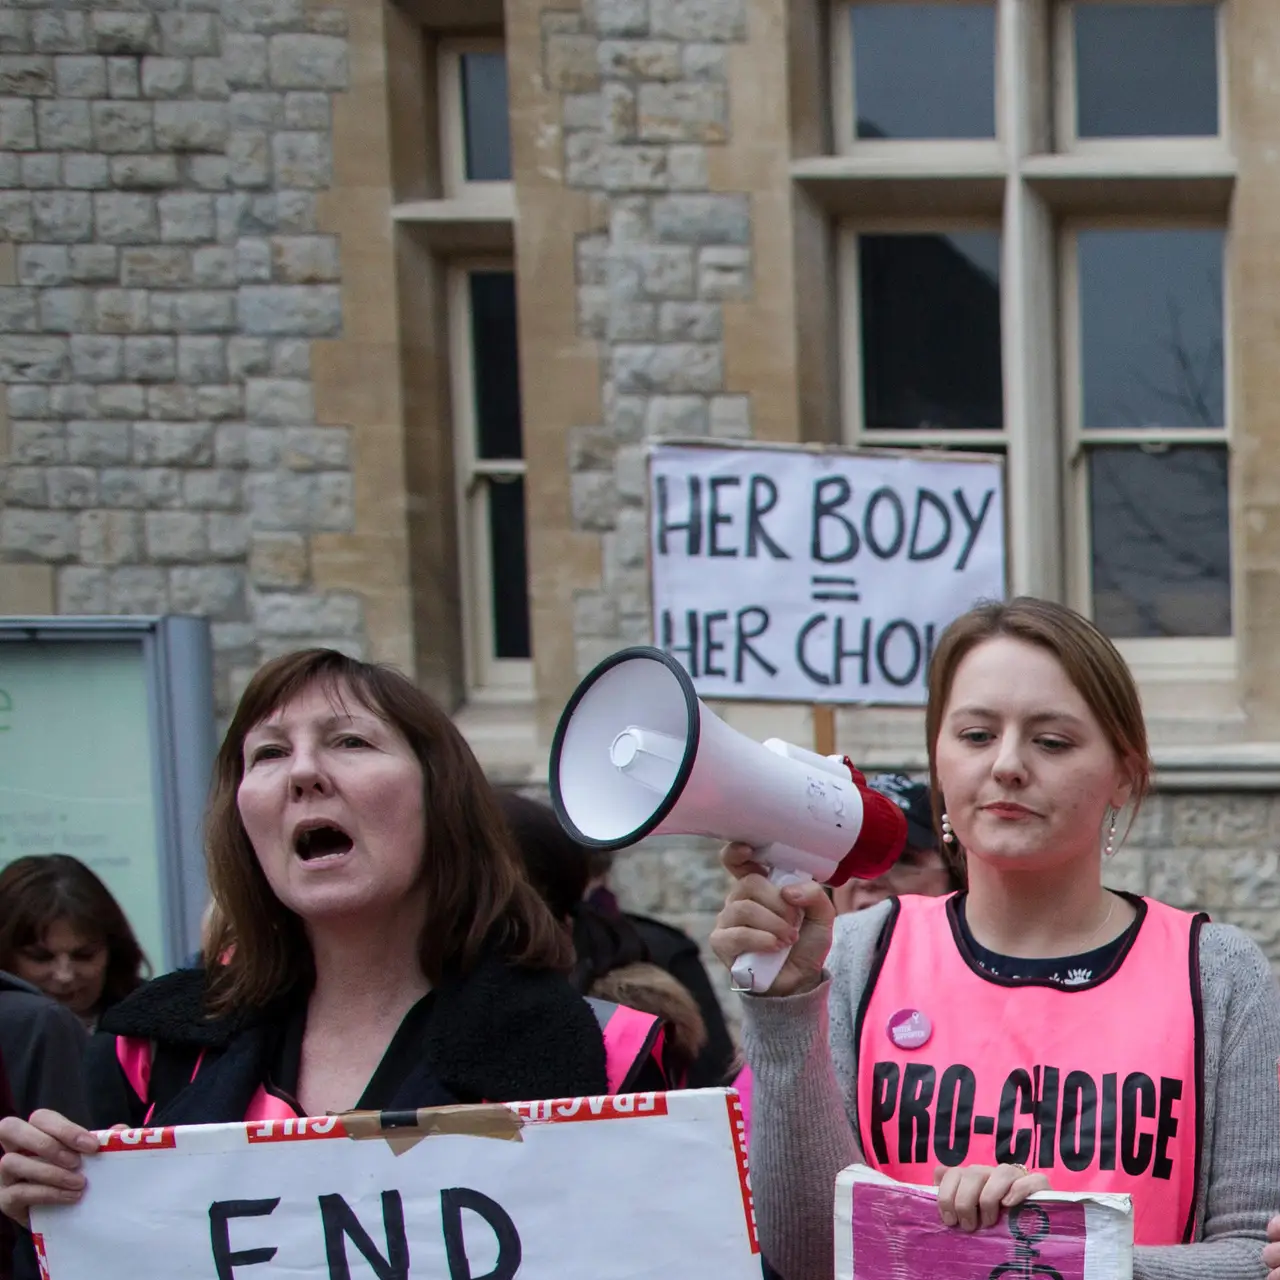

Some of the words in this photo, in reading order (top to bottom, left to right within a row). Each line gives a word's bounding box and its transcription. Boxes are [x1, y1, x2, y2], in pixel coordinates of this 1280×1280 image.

[656, 474, 791, 560] HER
[811, 475, 995, 571] BODY
[662, 606, 779, 683] HER
[797, 612, 934, 686] CHOI
[872, 1061, 1184, 1181] PRO-CHOICE
